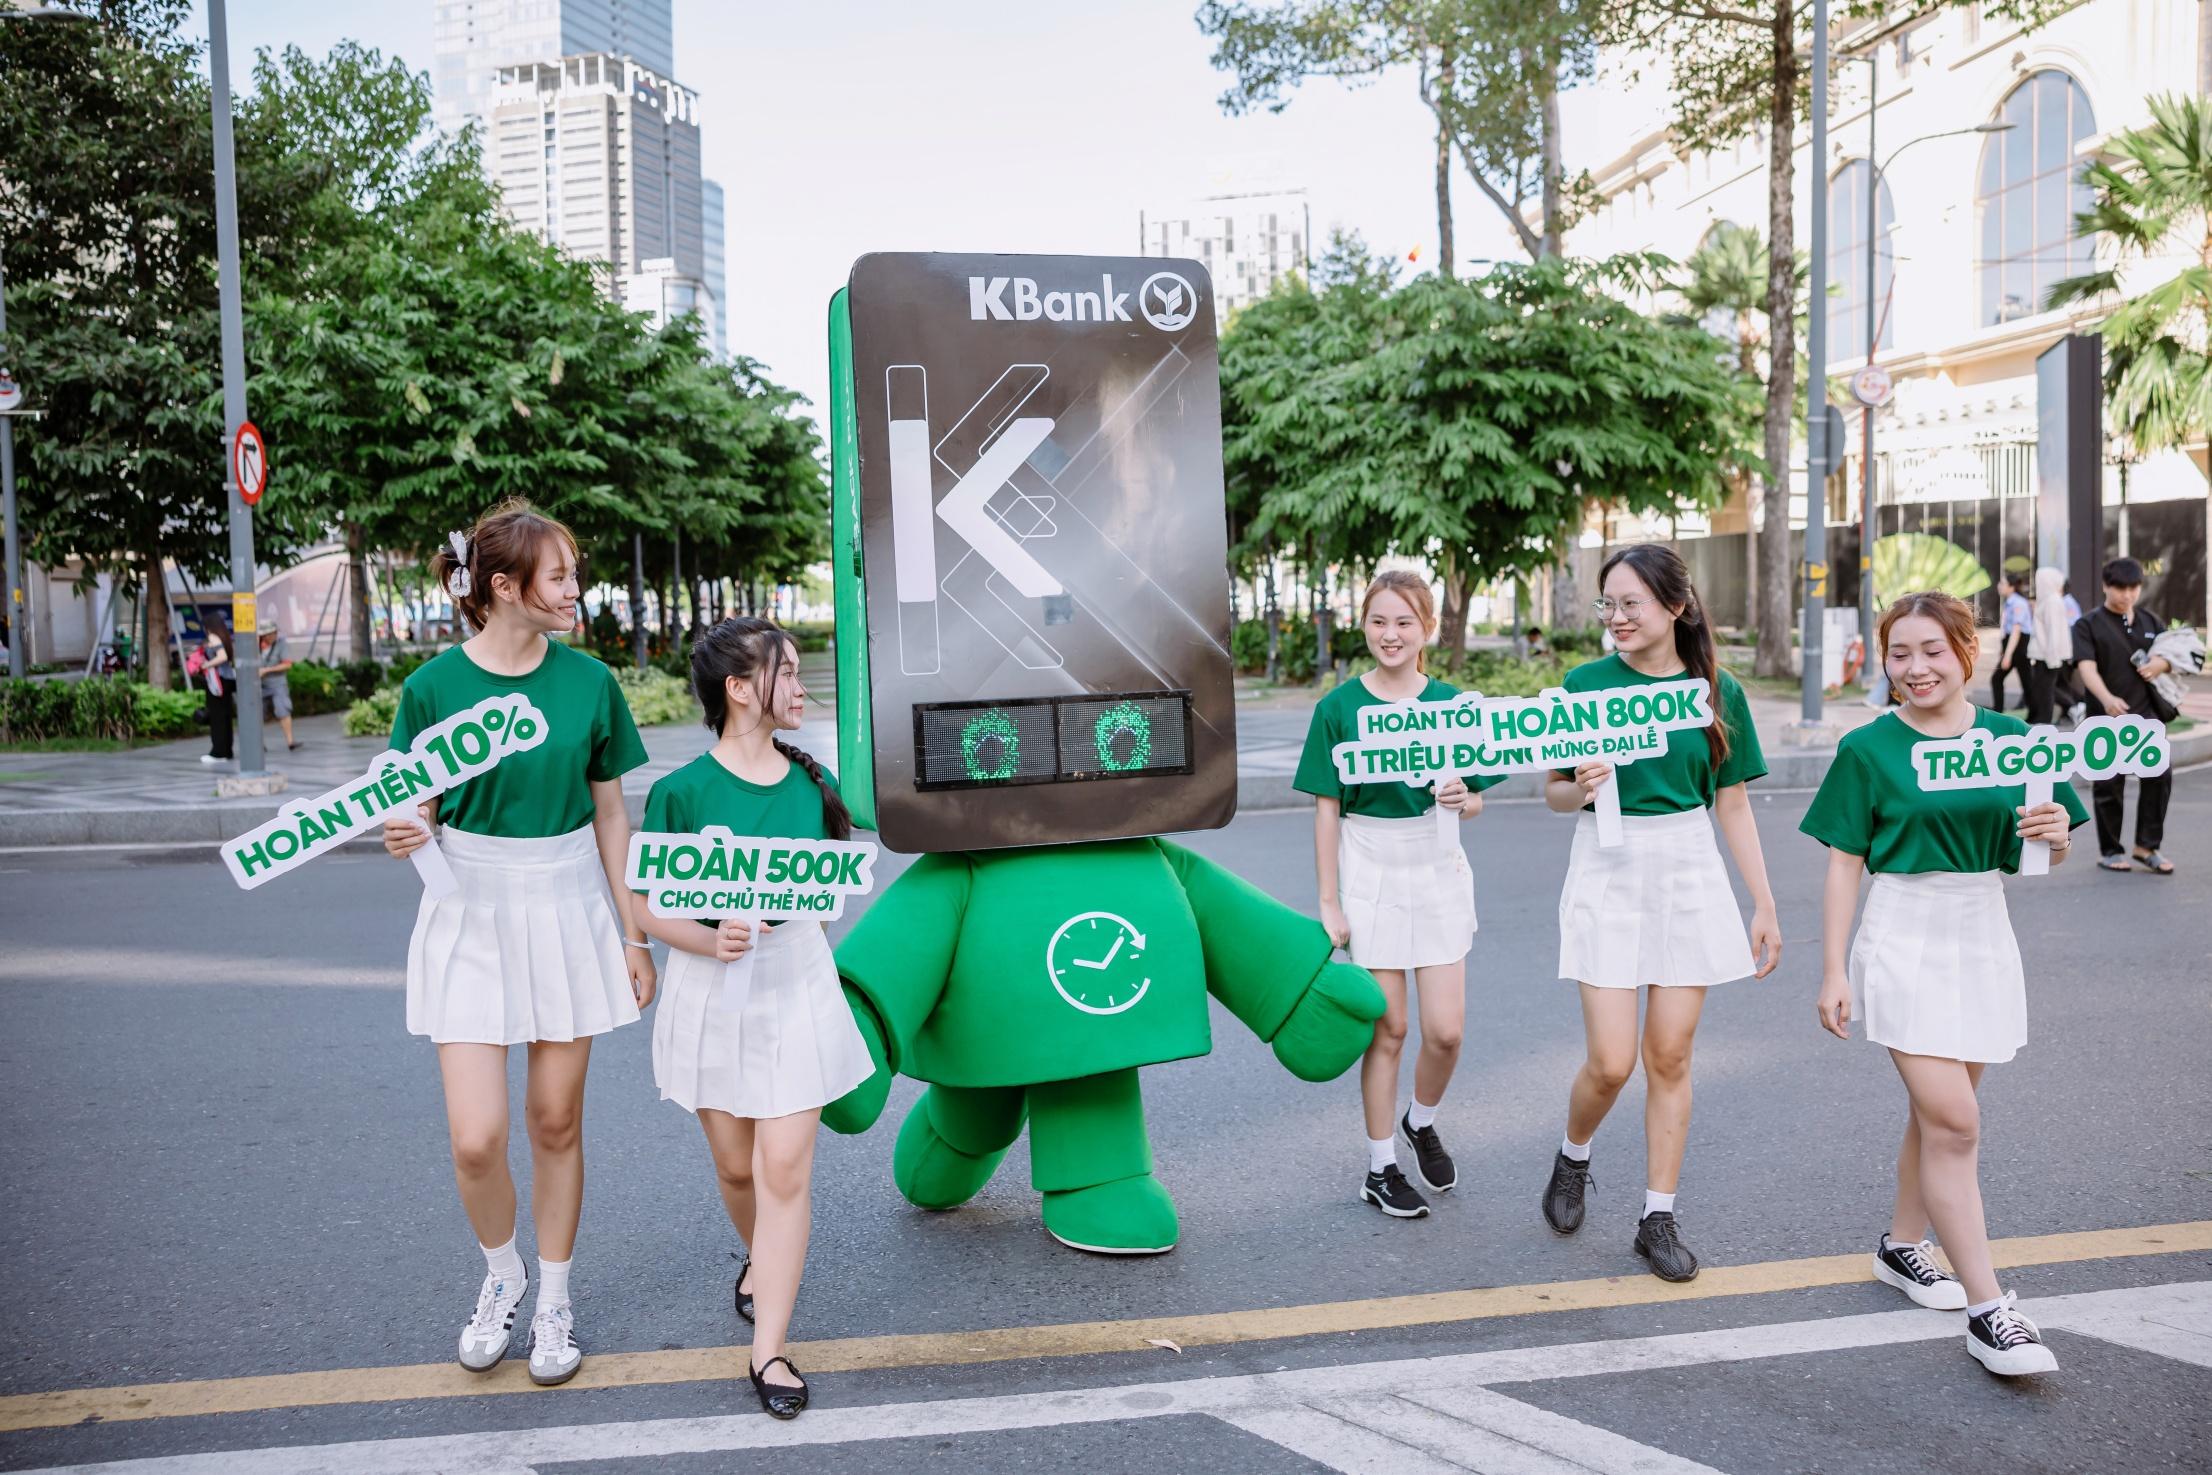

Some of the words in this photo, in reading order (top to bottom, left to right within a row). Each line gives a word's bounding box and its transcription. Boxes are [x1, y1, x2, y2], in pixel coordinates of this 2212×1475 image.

[969, 274, 1133, 322] KBank
[1367, 707, 1438, 734] HOÀN
[1490, 696, 1600, 742] HOÀN
[1605, 687, 1703, 728] 800K
[1342, 750, 1356, 776] 1
[1360, 740, 1446, 779] TRIỆU
[1541, 739, 1599, 761] MỪNG
[1601, 735, 1635, 757] ĐẠI
[1637, 726, 1659, 750] LỄ
[1923, 738, 1991, 781] TRẢ
[1996, 735, 2077, 776] GÓP
[2083, 724, 2162, 771] 0%
[234, 810, 354, 878] HOÀN
[348, 760, 434, 818] TIỀN
[424, 705, 538, 777] 10%
[637, 837, 761, 883] HOÀN
[765, 849, 867, 886] 500K
[659, 889, 708, 909] CHO
[710, 886, 755, 910] CHỦ
[757, 888, 794, 911] THẺ
[796, 889, 836, 912] MỚI
